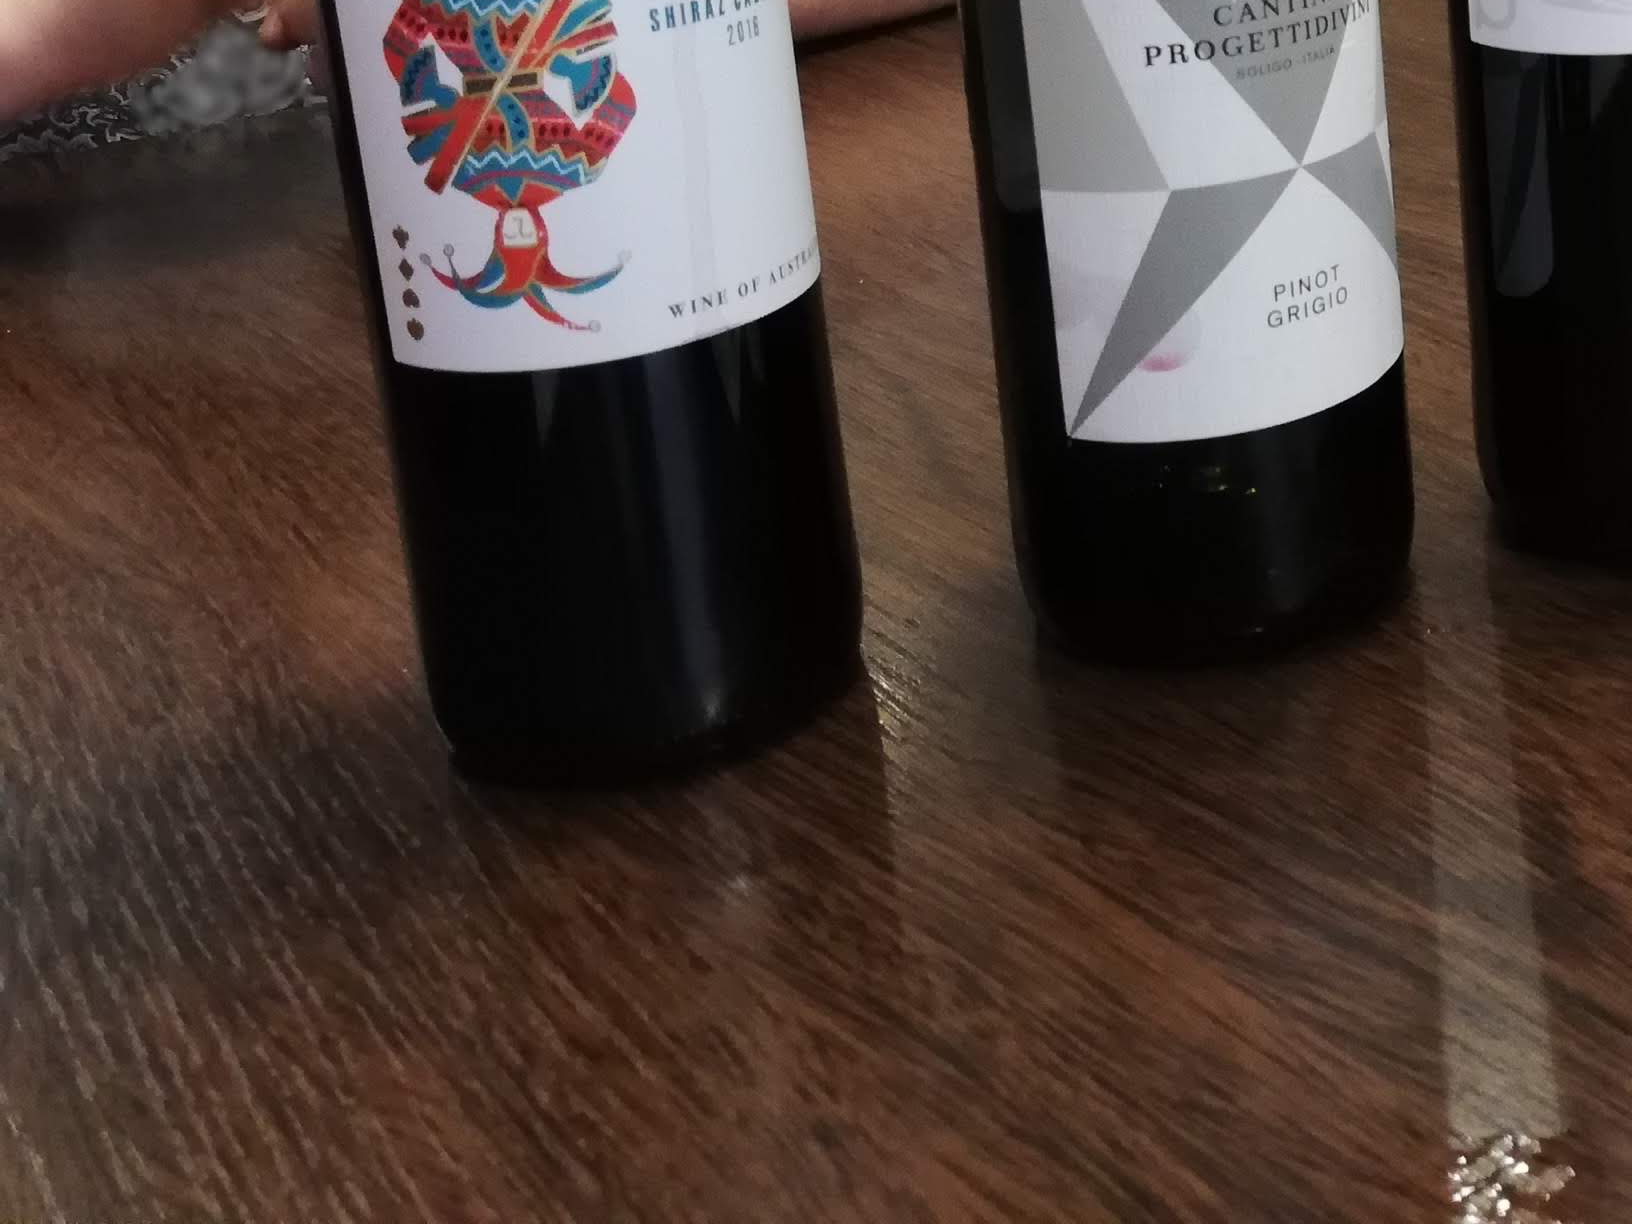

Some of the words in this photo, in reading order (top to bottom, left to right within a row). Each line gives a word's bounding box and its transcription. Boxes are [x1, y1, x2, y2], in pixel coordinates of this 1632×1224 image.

[667, 289, 728, 319] WINE
[738, 276, 761, 297] OF
[1273, 264, 1340, 302] PINOT
[1267, 287, 1348, 328] GRIGIO
